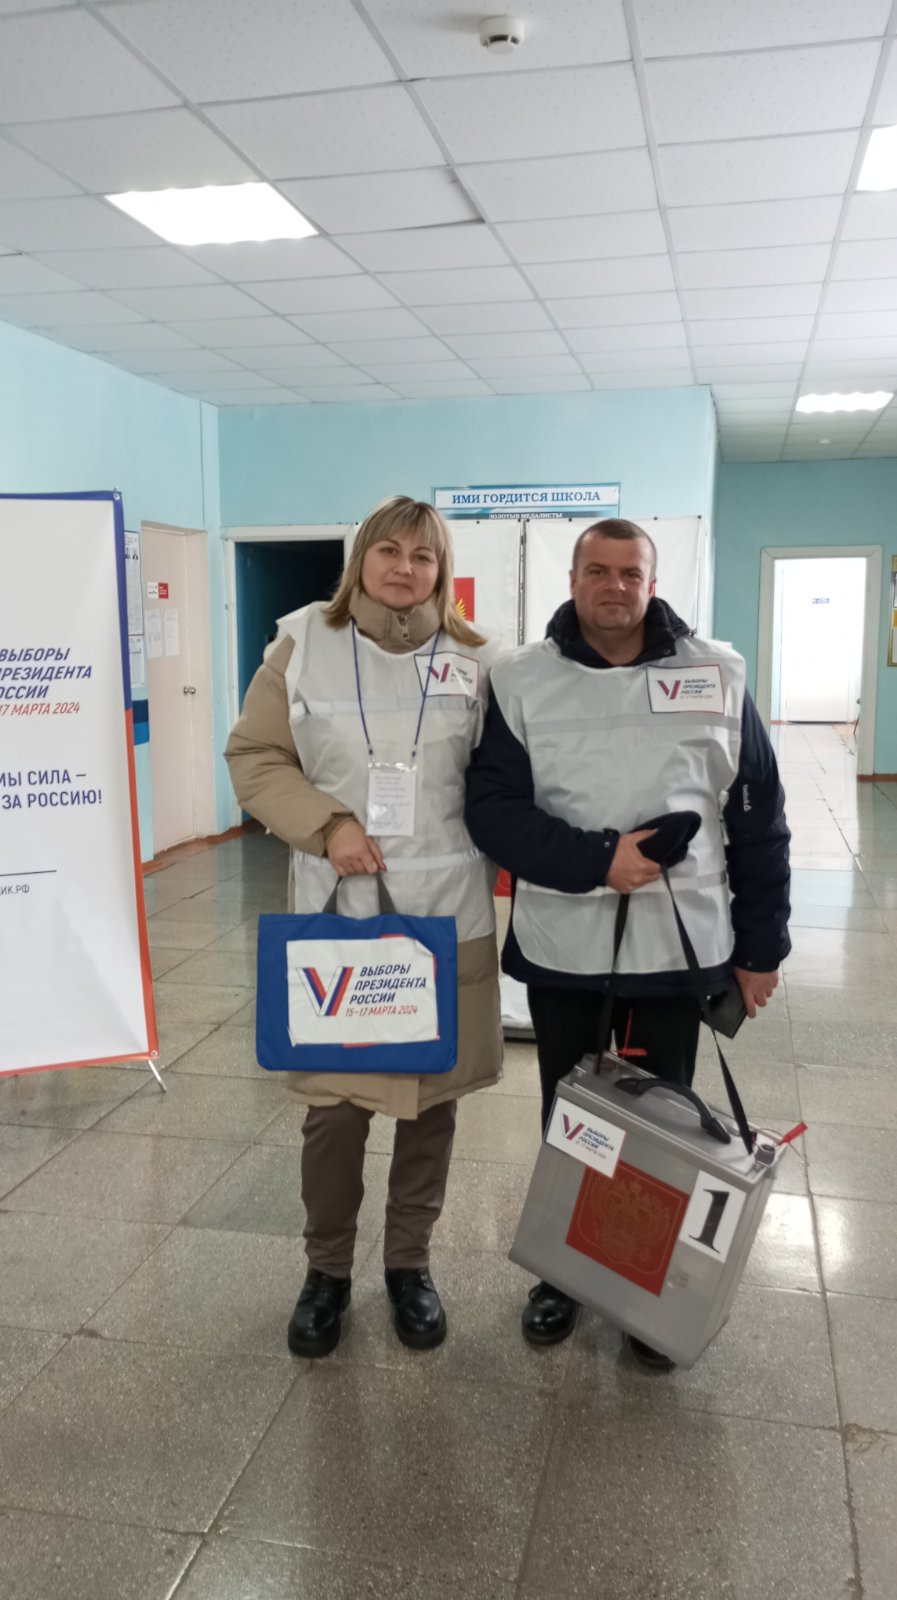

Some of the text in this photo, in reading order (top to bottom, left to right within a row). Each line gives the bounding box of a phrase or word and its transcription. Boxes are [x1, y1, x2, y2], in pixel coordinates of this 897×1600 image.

[452, 491, 600, 505] ИМИ ГОРДИТСЯ ШКОЛА
[0, 648, 71, 662] ВЫБОРЫ
[0, 665, 92, 682] РЕЗИДЕНТА
[11, 703, 51, 716] МАРТА
[52, 701, 80, 714] 2024
[27, 769, 72, 786] СИЛА
[1, 788, 102, 809] ЗА РОССИЮ!
[0, 884, 30, 896] ИК.РФ
[360, 963, 411, 977] ВЫБОРЫ
[354, 977, 427, 990] ПРЕЗИДЕНТА
[349, 992, 396, 1005] РОССИИ
[368, 1005, 397, 1016] МАРТА
[397, 1004, 418, 1015] 2024
[688, 1188, 730, 1254] 1
